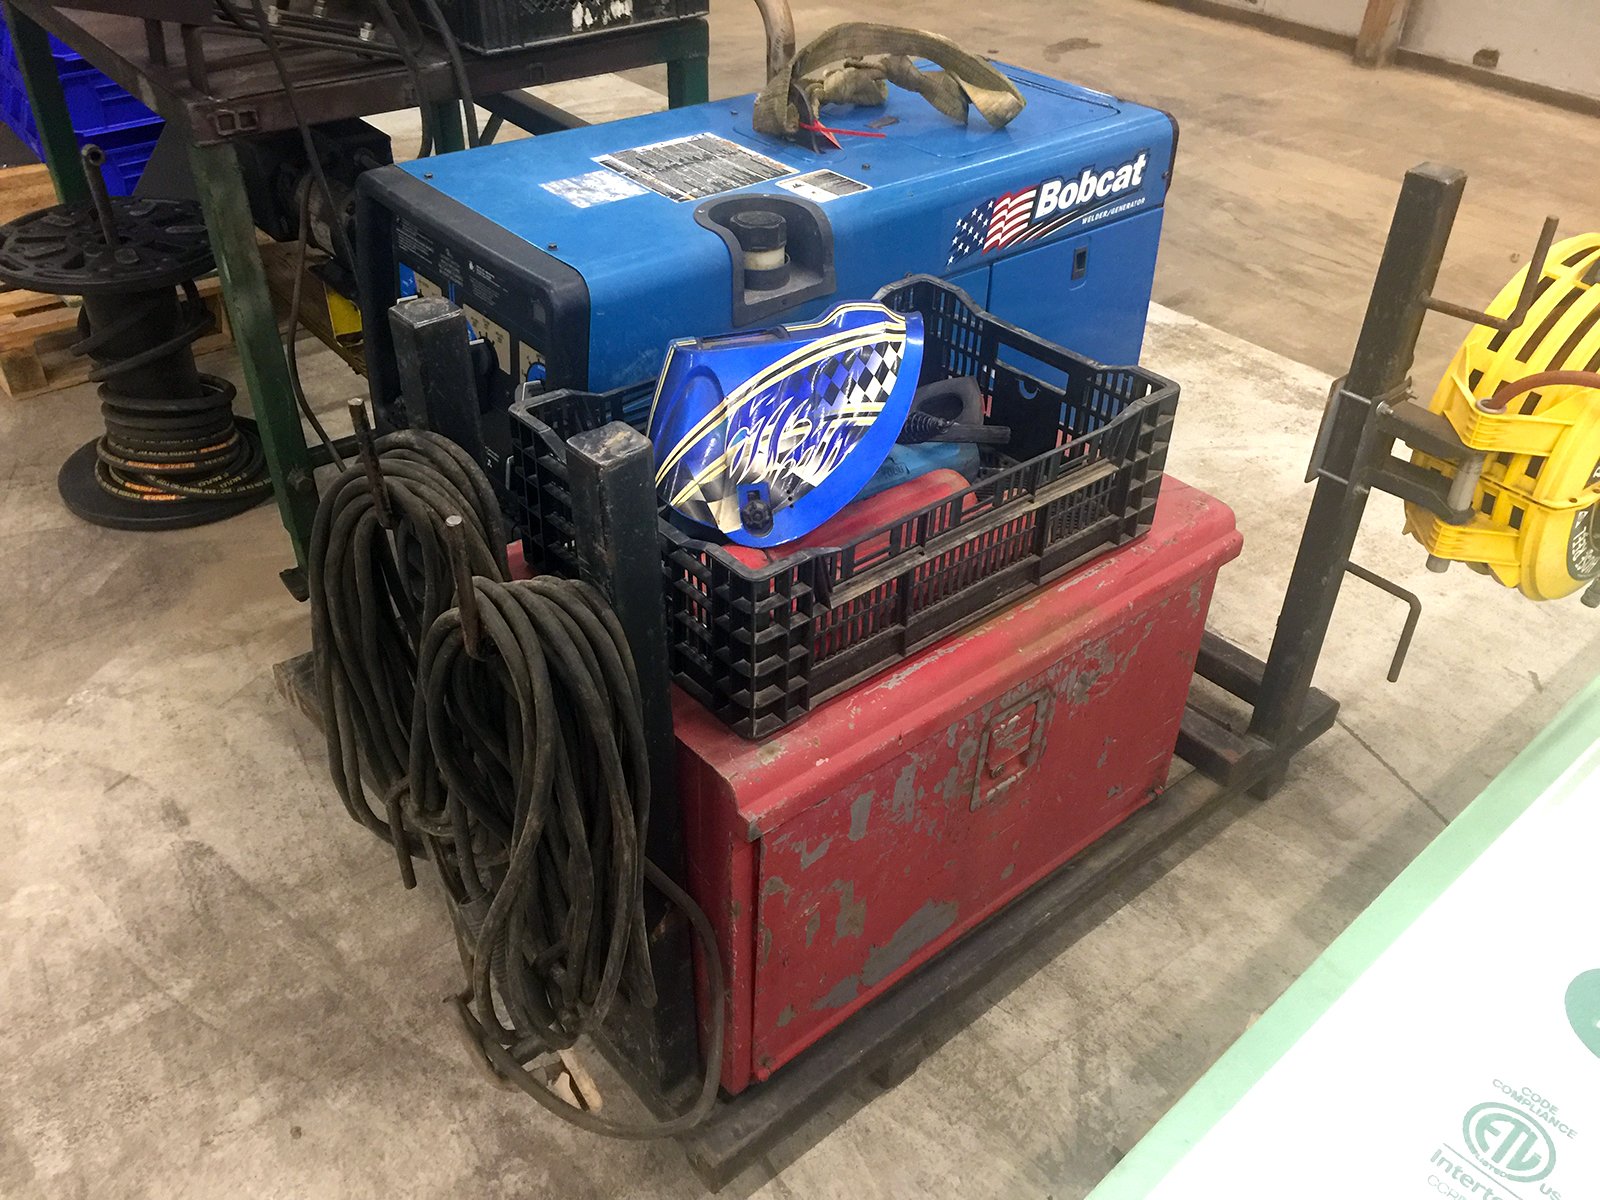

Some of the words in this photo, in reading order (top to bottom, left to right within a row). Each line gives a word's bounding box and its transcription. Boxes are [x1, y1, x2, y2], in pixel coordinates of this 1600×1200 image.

[1034, 151, 1148, 219] Bobcat
[1081, 197, 1147, 225] WELDER/GENERATOR
[1492, 1078, 1578, 1139] COMPLIANCE
[1521, 1086, 1559, 1115] CODE
